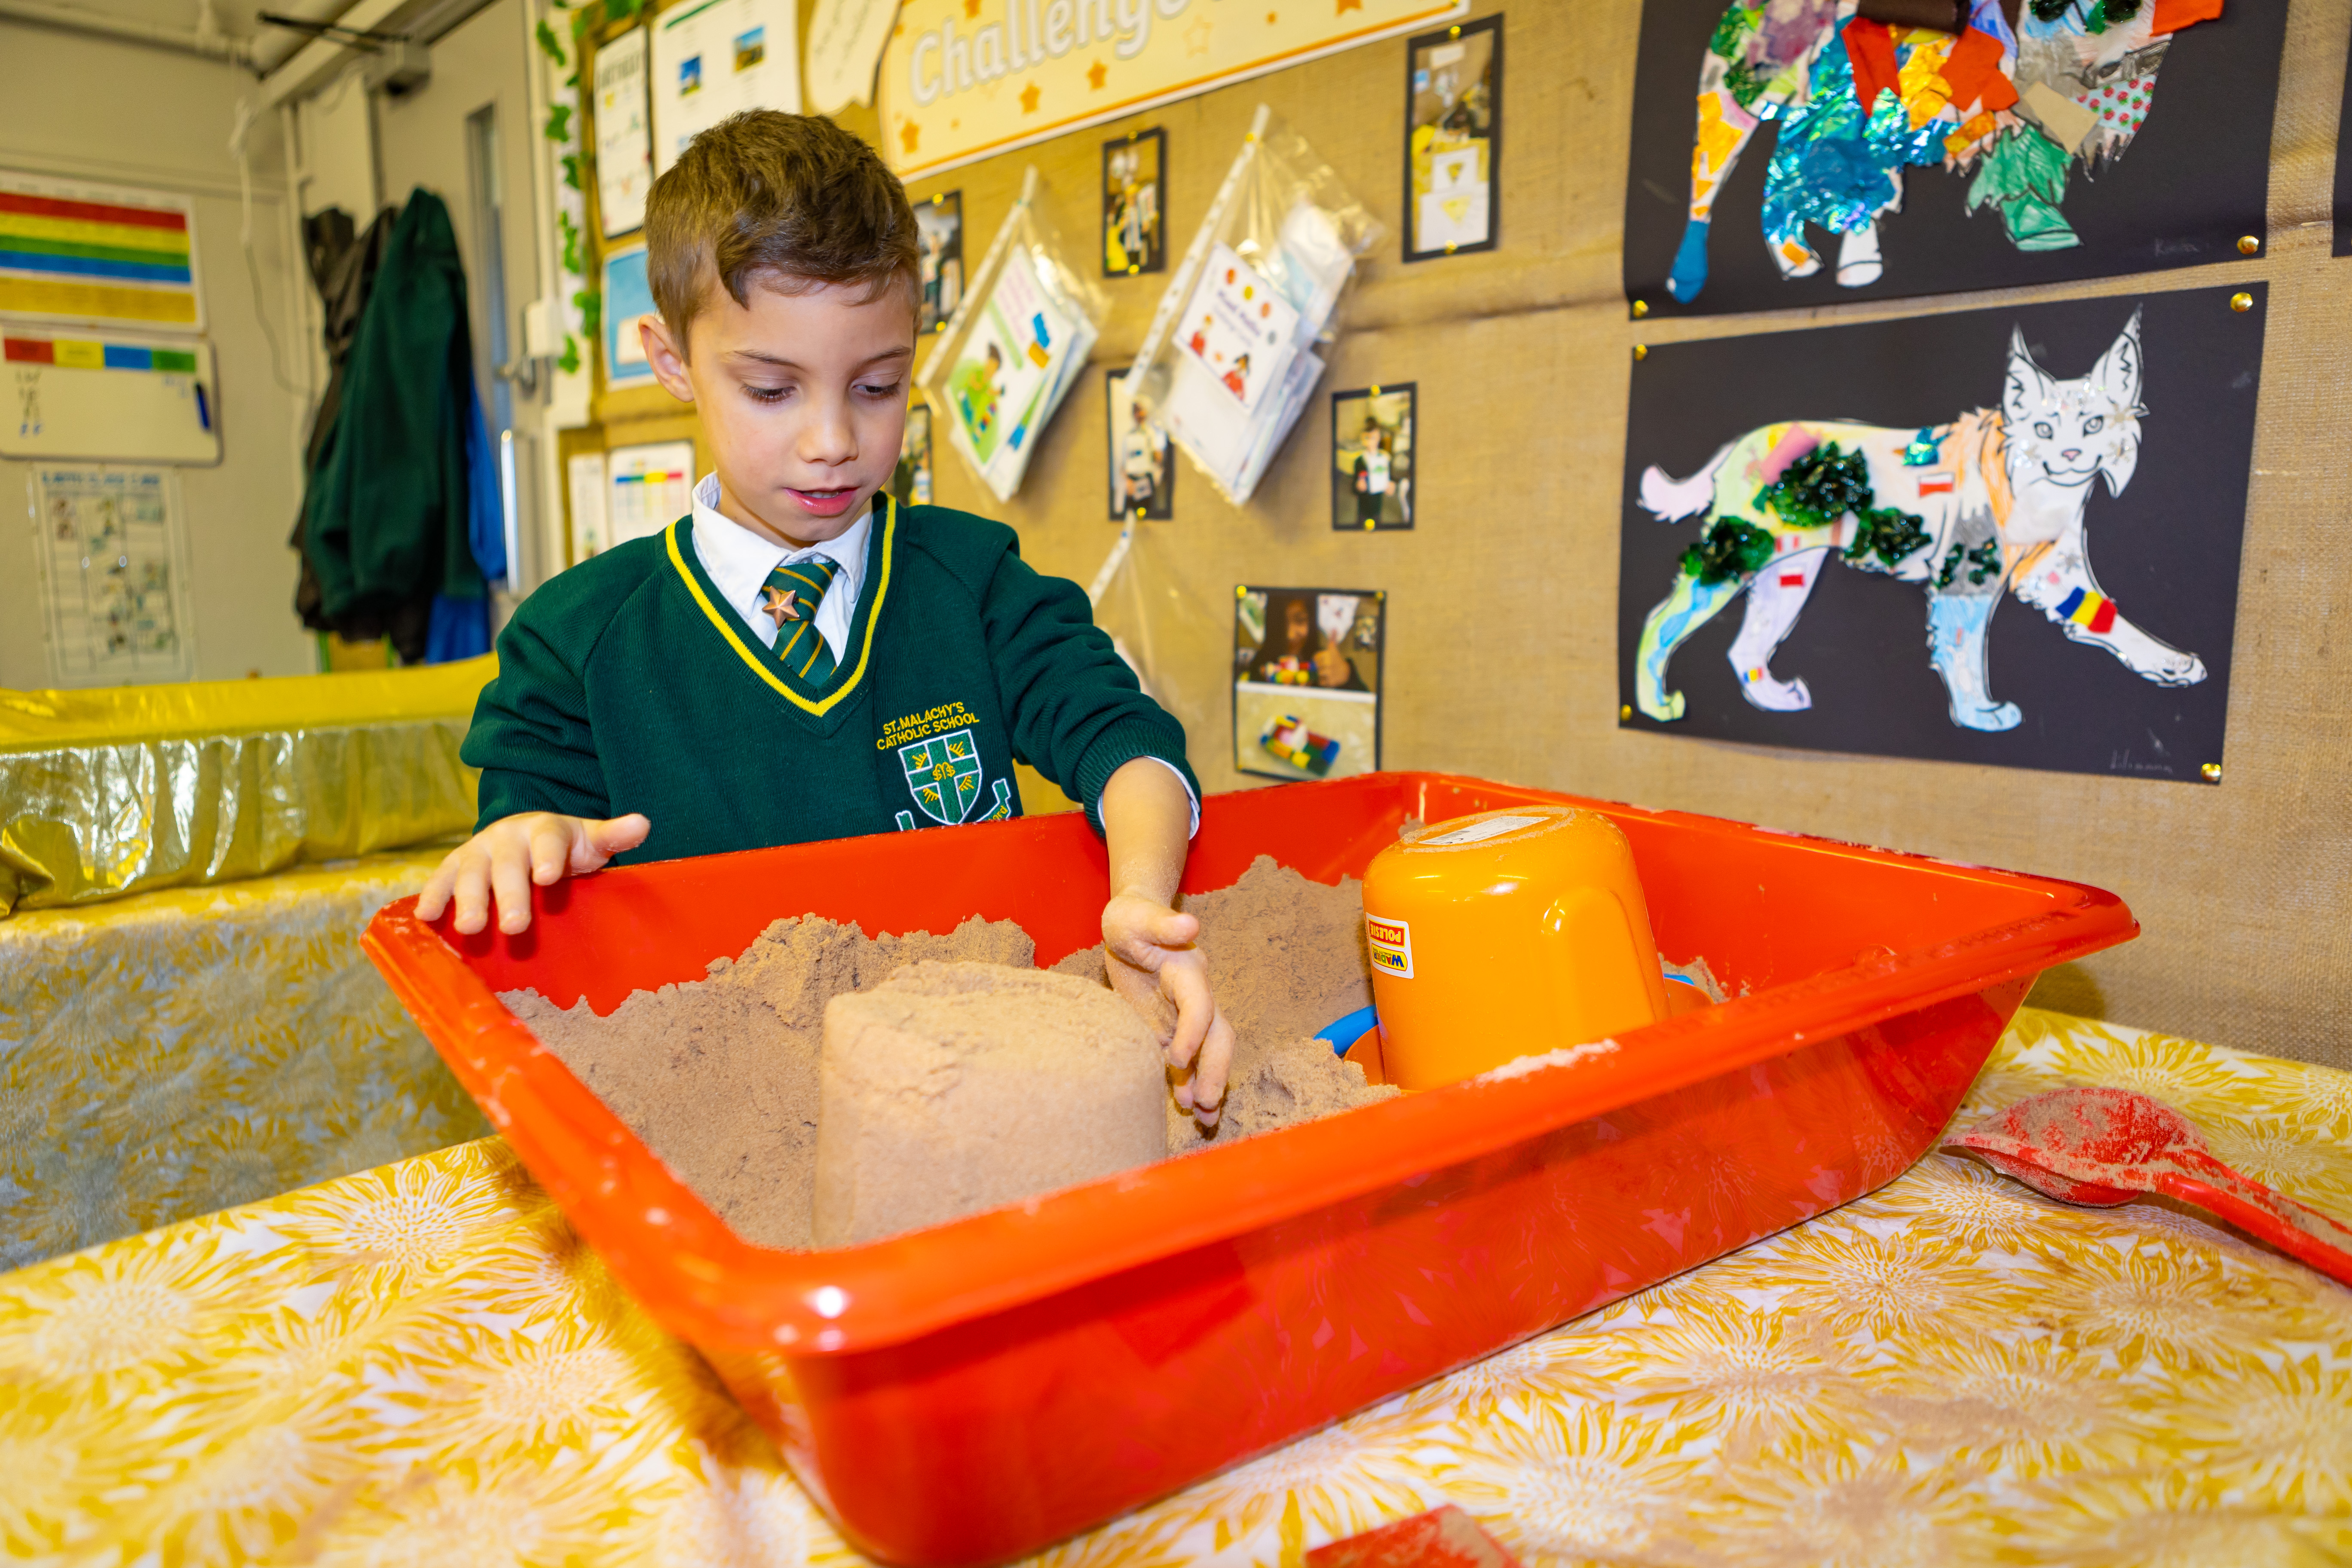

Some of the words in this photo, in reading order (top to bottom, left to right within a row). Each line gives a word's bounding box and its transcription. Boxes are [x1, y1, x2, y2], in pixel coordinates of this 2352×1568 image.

[876, 723, 931, 750] CATHOLIC
[932, 712, 980, 733] SCHOOL
[990, 805, 1008, 820] ord
[1370, 924, 1401, 943] POLESIE
[1373, 951, 1405, 968] WADER
